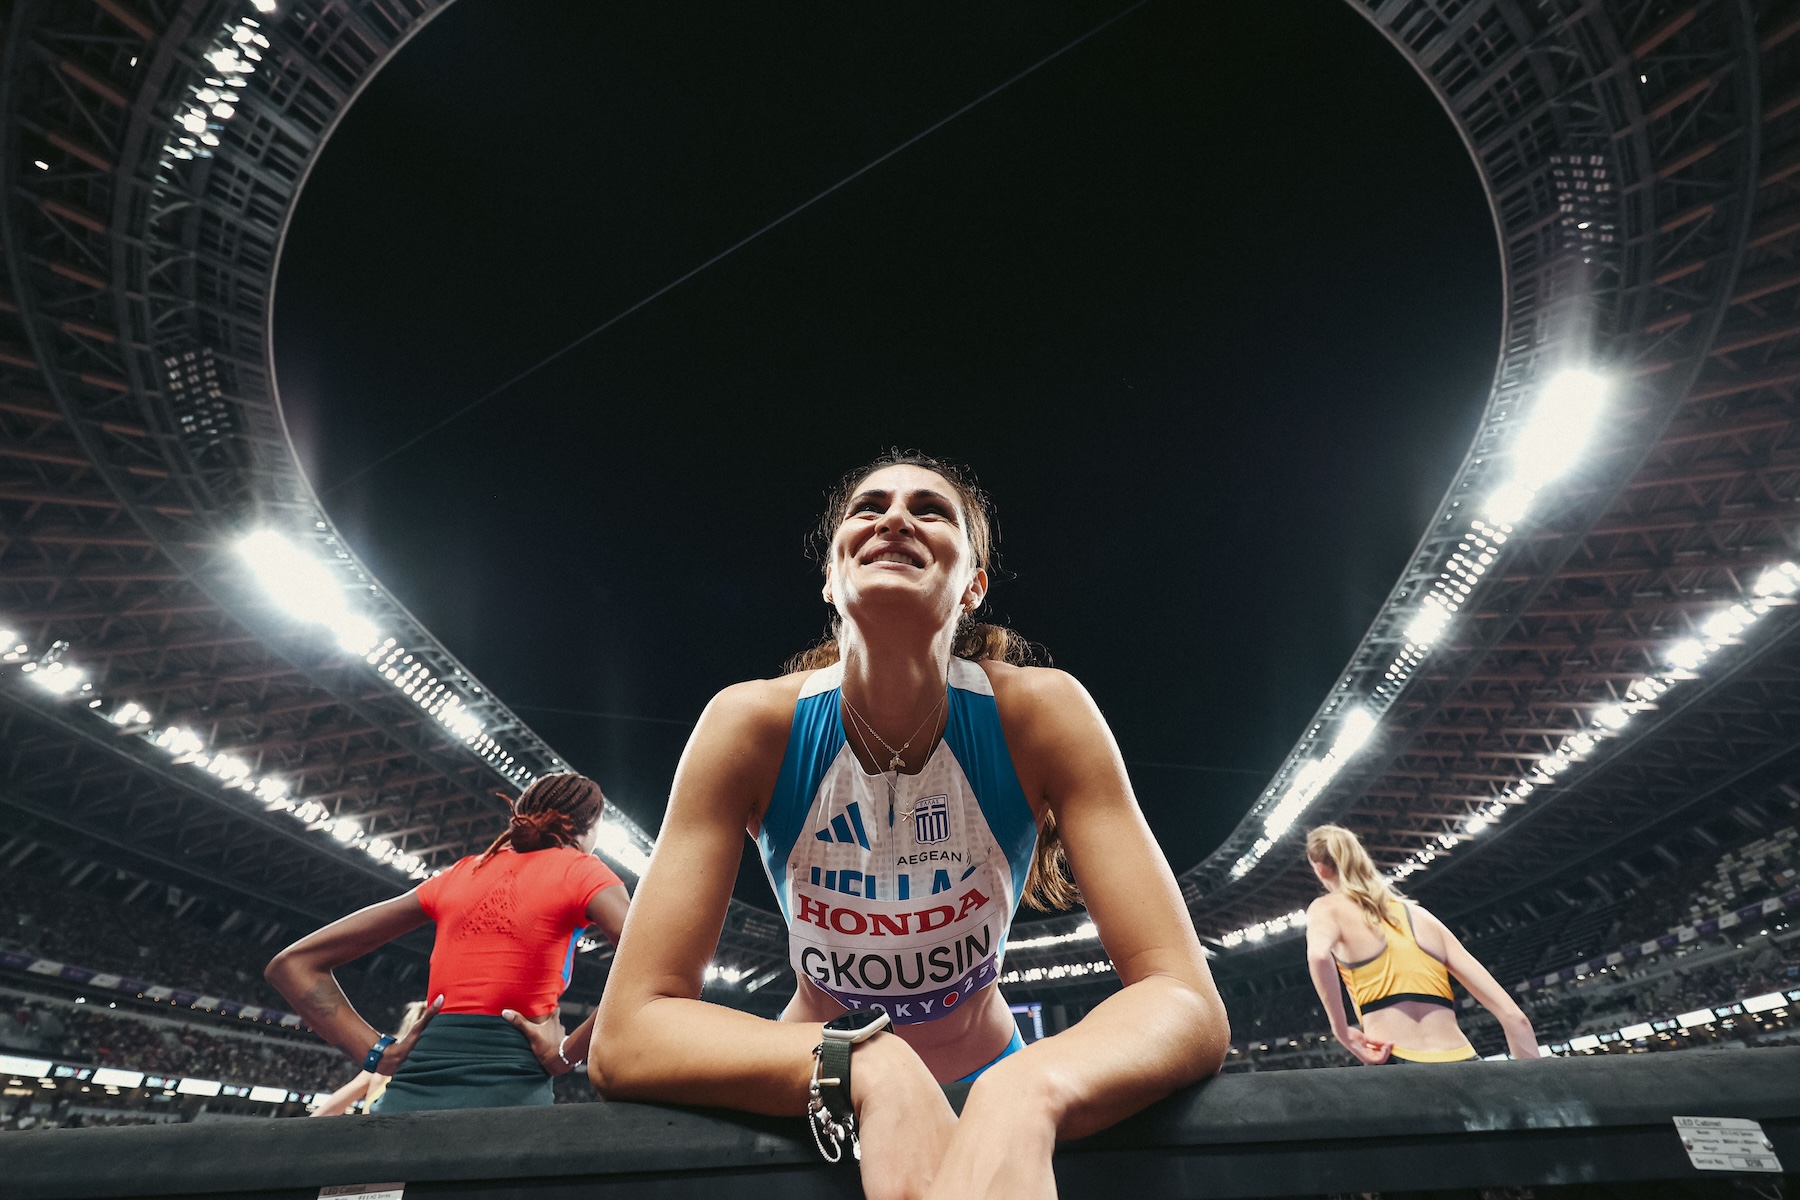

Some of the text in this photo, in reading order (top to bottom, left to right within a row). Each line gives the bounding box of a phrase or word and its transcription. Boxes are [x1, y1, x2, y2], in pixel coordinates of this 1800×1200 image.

[897, 850, 962, 865] AEGEAN
[797, 888, 990, 936] HONDA
[801, 924, 990, 990] GKOUSIN
[964, 965, 990, 993] 25
